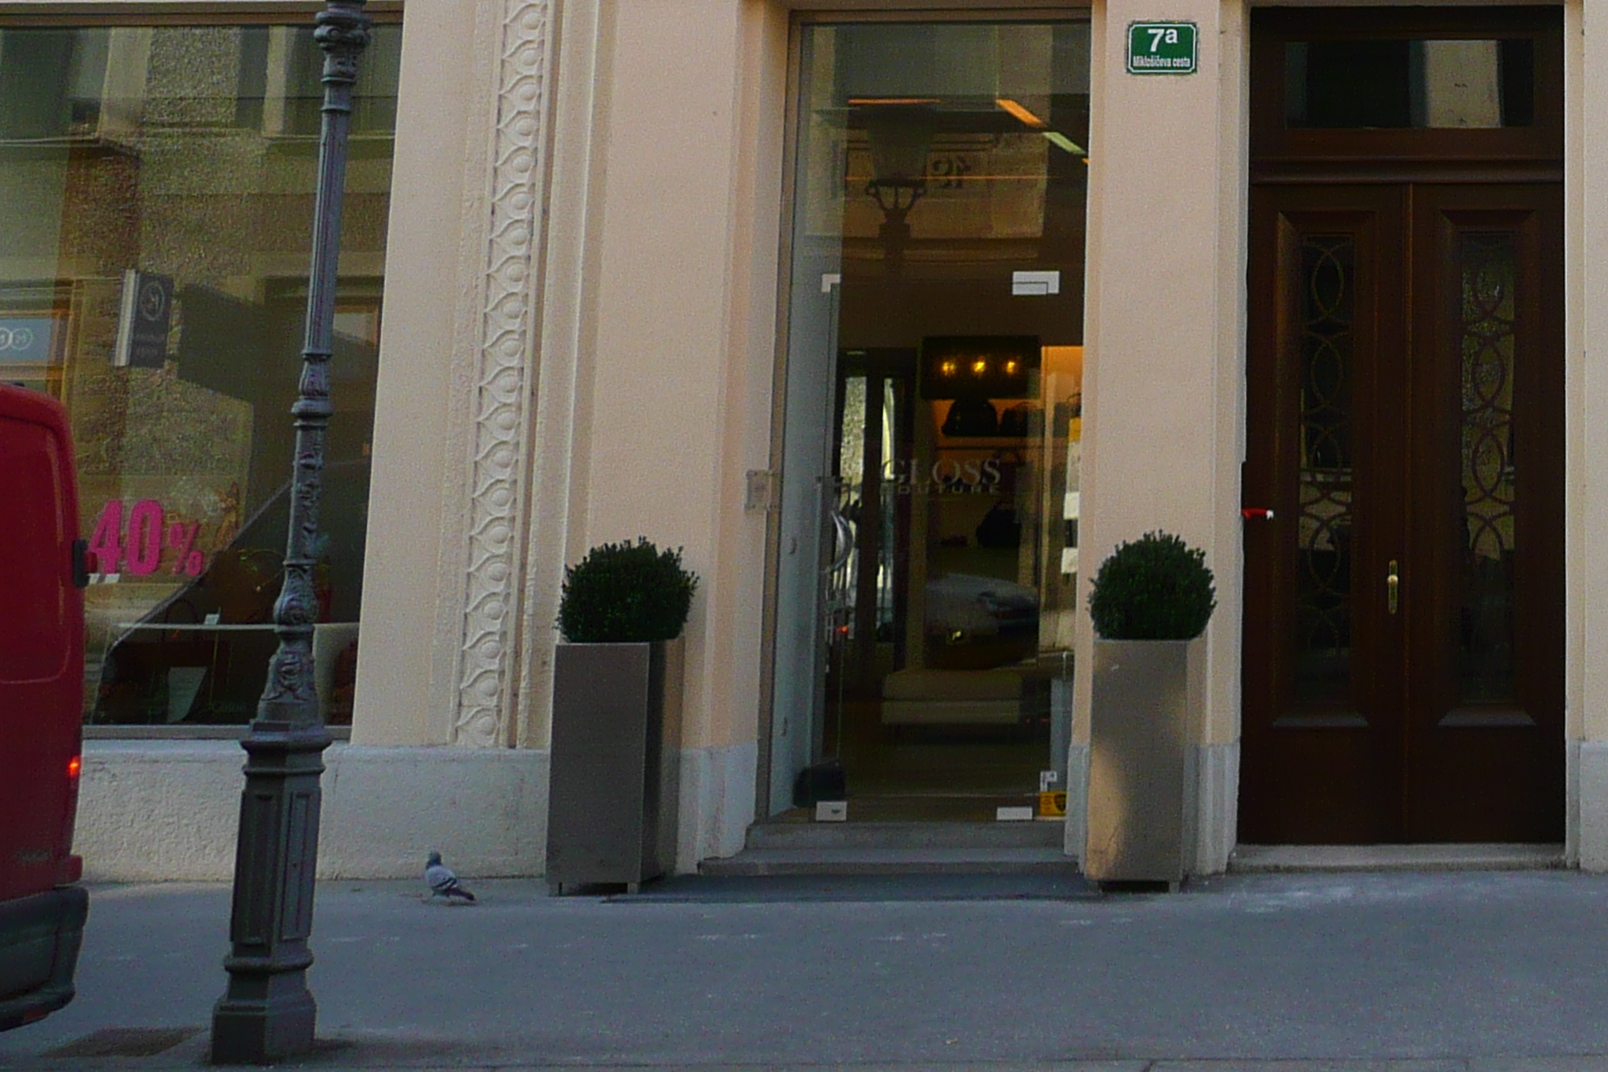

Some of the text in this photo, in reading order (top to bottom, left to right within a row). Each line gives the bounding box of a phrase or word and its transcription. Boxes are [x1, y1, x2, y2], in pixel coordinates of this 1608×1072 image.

[1147, 28, 1178, 53] 7a
[1172, 57, 1191, 67] cesta
[881, 458, 1001, 485] GLOSS
[87, 499, 205, 577] 40%
